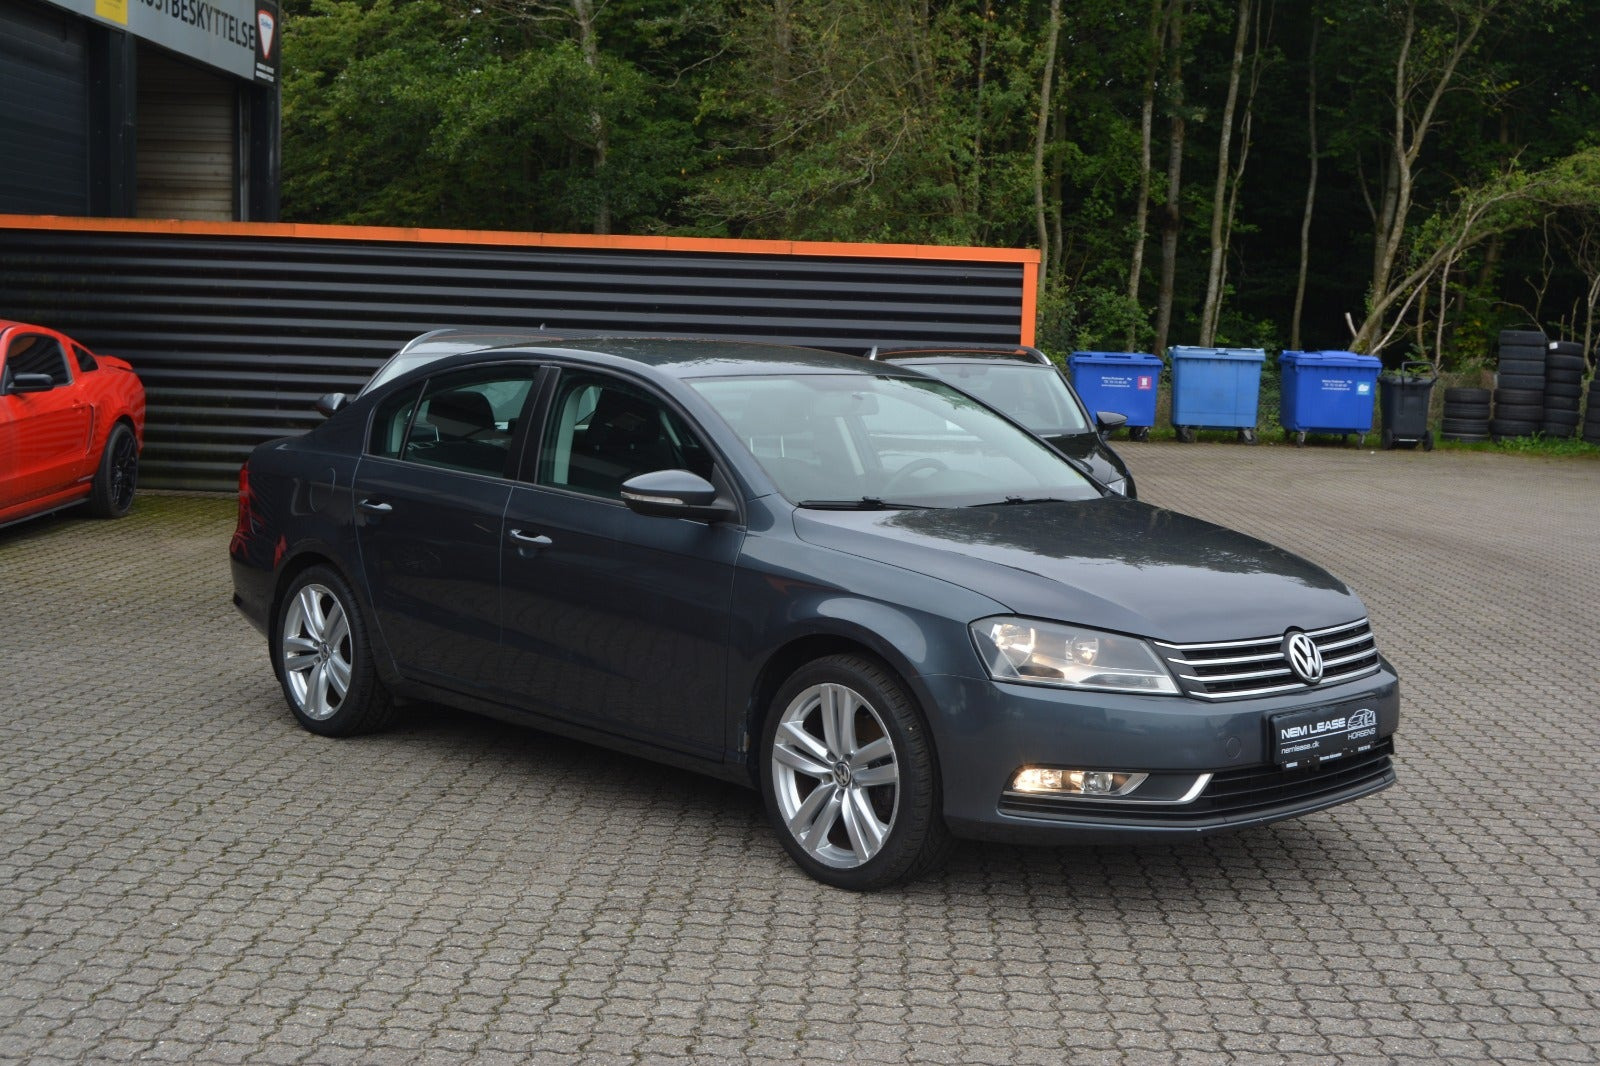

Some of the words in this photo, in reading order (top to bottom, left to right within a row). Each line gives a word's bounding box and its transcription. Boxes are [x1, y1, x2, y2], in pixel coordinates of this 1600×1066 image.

[138, 0, 255, 51] BESKYTTELSE
[1281, 725, 1308, 740] NEM
[1309, 717, 1346, 734] LEASE
[1347, 727, 1376, 741] HORSENS
[1281, 740, 1320, 755] nemlease.dk
